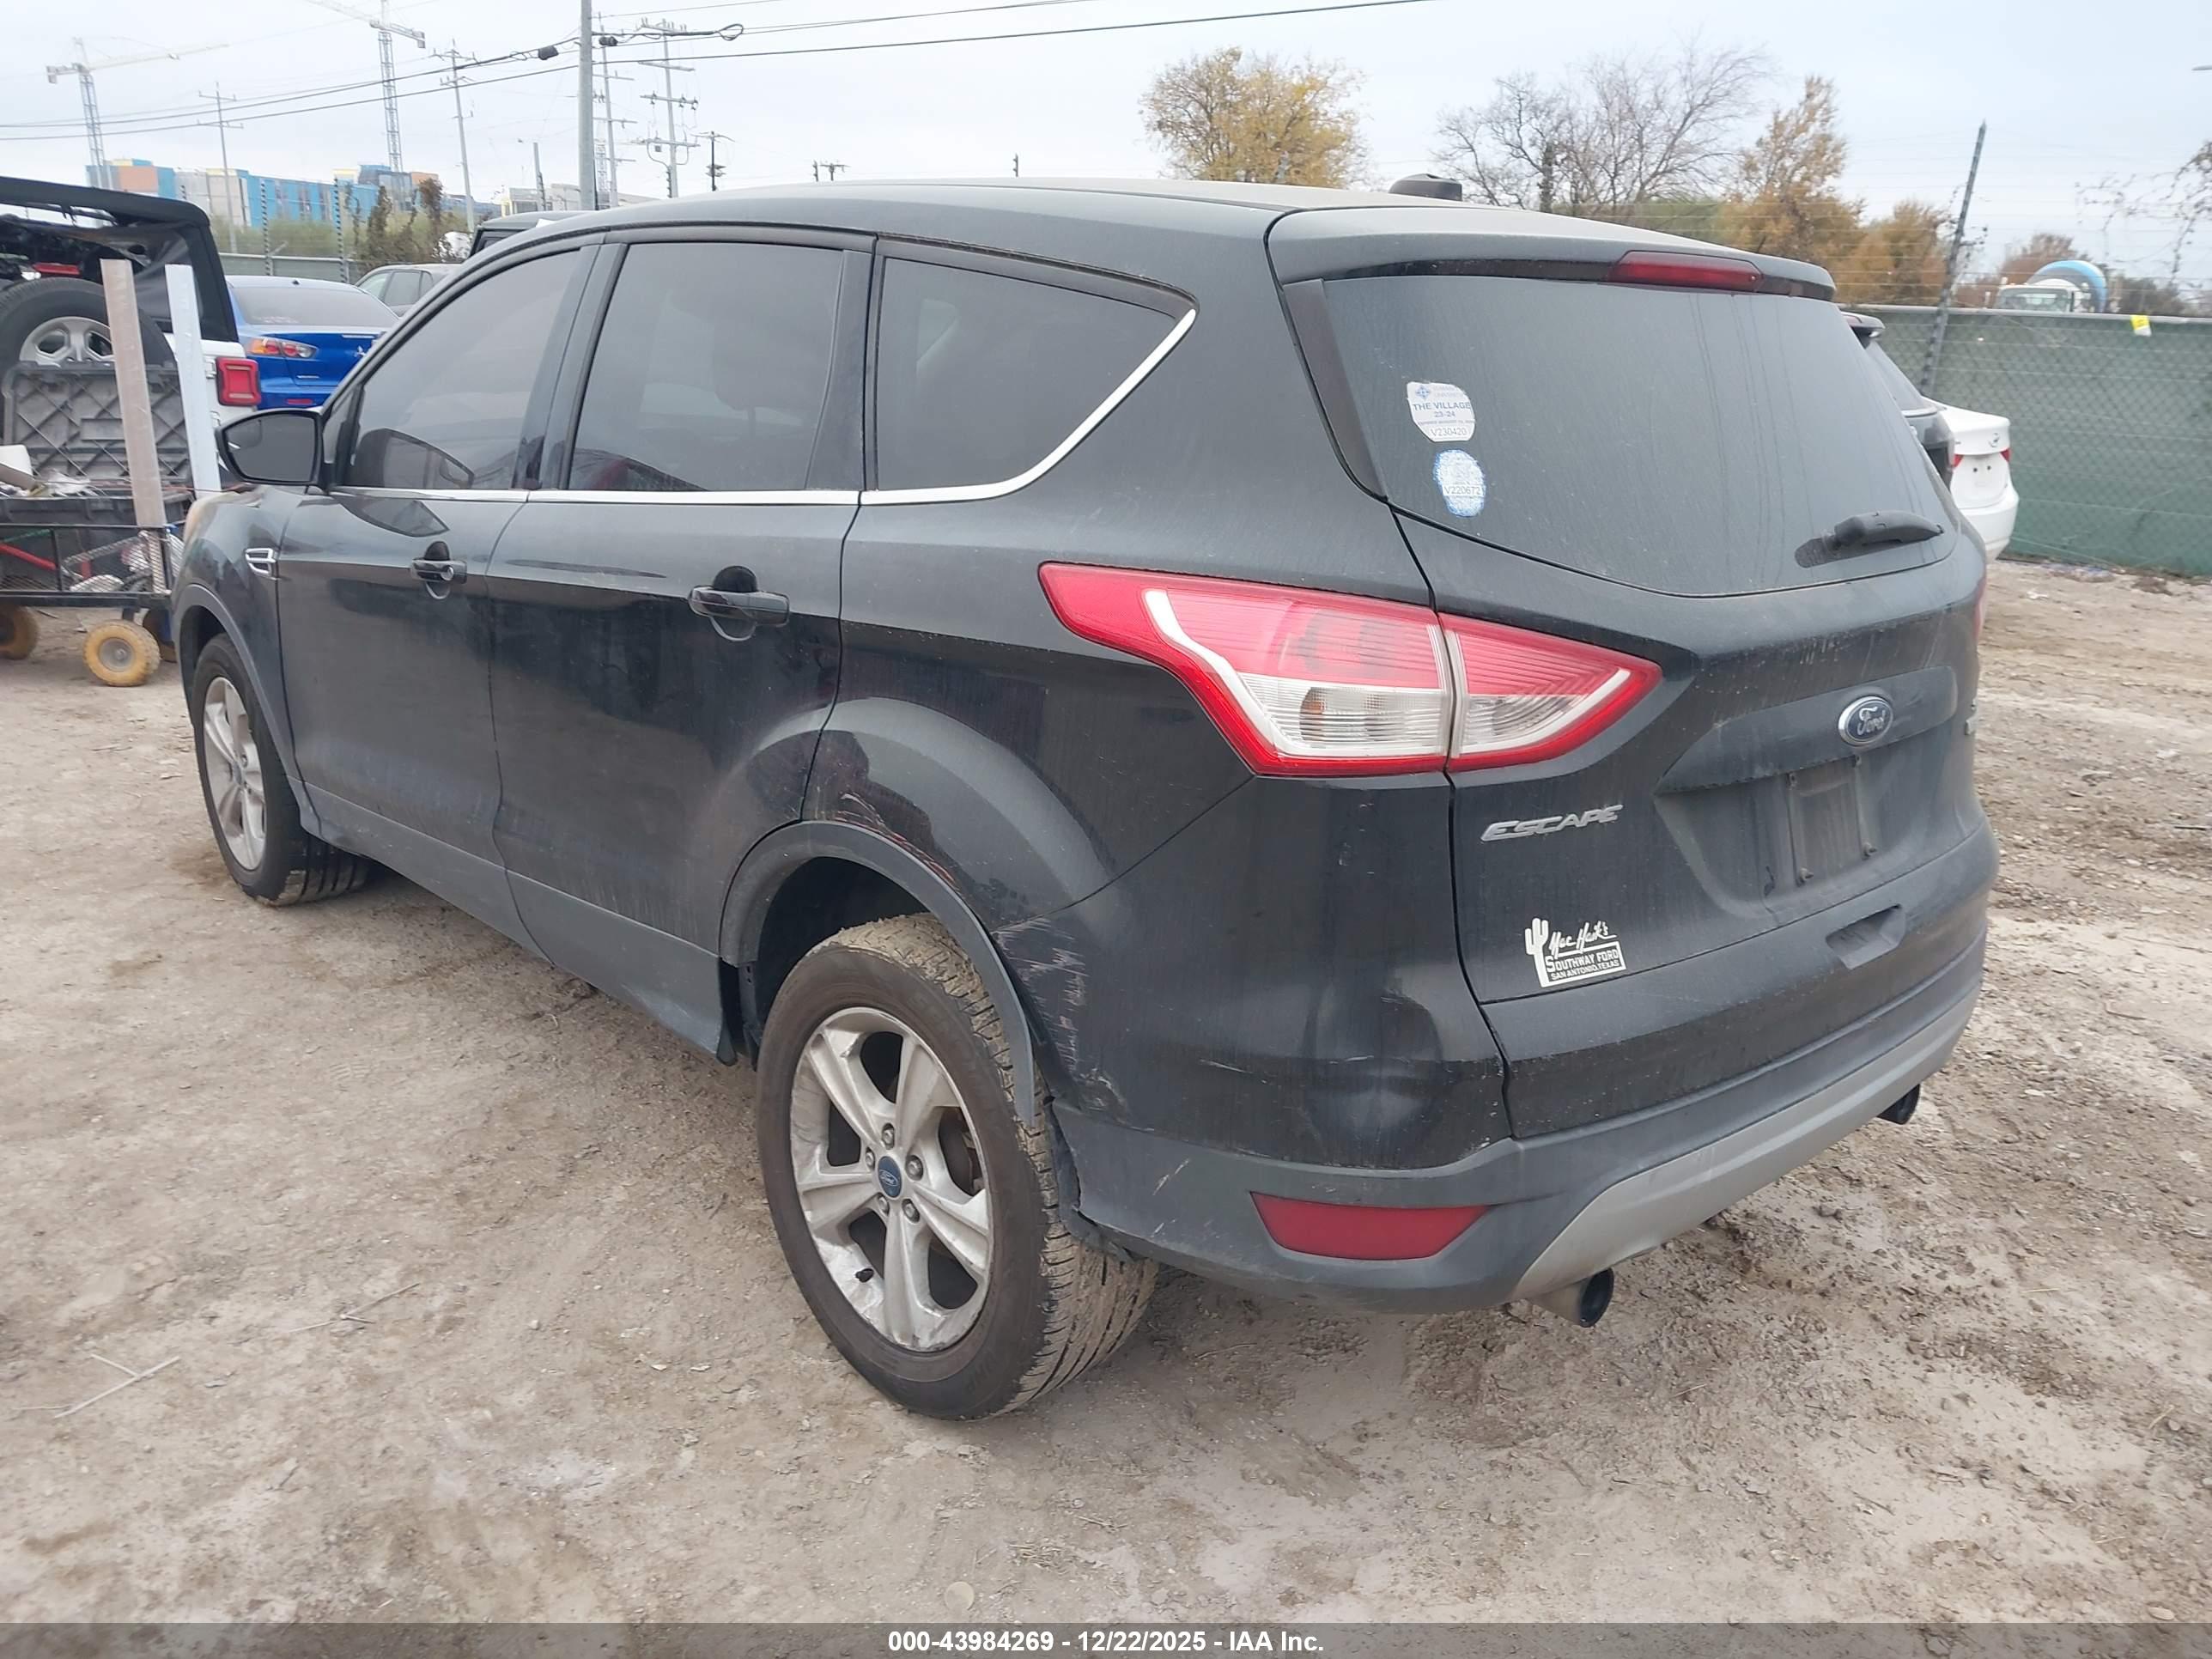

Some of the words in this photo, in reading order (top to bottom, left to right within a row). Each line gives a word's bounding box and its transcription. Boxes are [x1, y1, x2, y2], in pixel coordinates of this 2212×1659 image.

[1413, 402, 1431, 410] THE
[1433, 401, 1471, 410] VILLAGE
[1480, 805, 1624, 842] ESCAPE
[1546, 955, 1595, 973] SOUTHWAY
[1596, 949, 1619, 963] FORD
[1551, 970, 1566, 981] SAN
[1599, 959, 1620, 971] TEXAS
